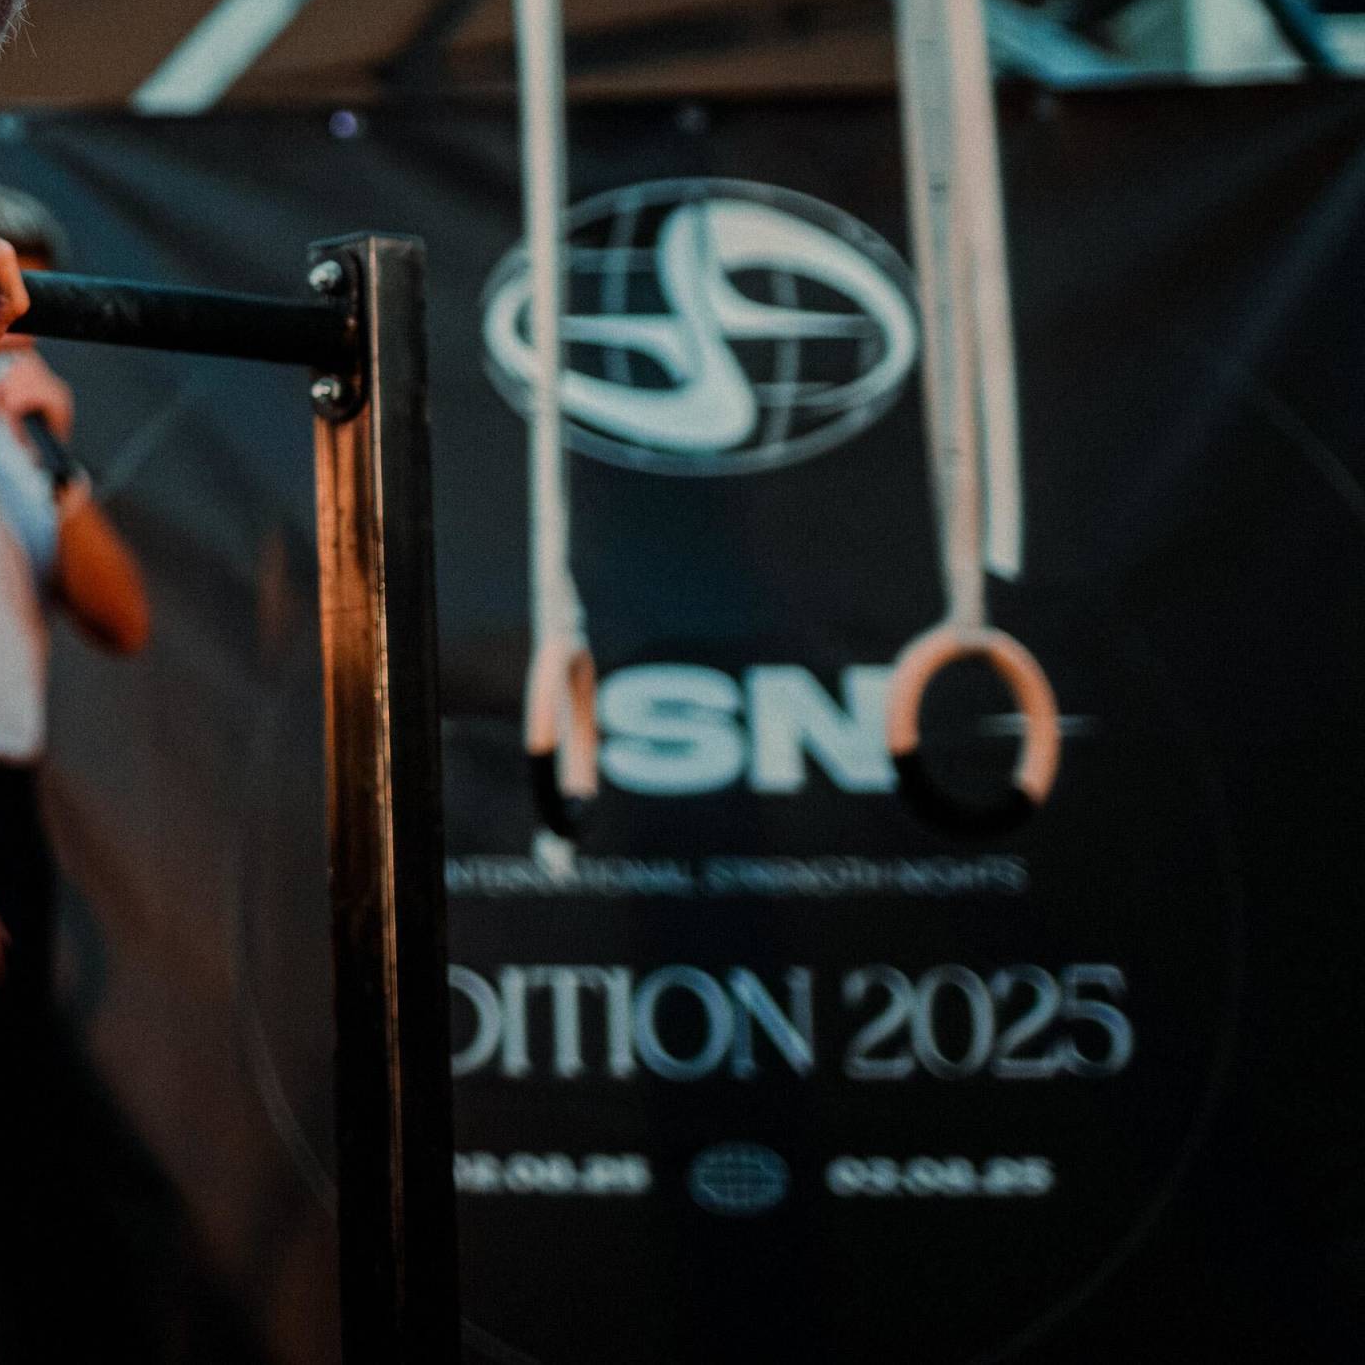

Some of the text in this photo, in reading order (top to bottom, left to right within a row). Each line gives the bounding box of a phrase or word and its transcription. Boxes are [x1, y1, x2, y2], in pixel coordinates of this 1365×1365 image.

[597, 662, 901, 795] SN
[448, 964, 1134, 1080] DITION 2025
